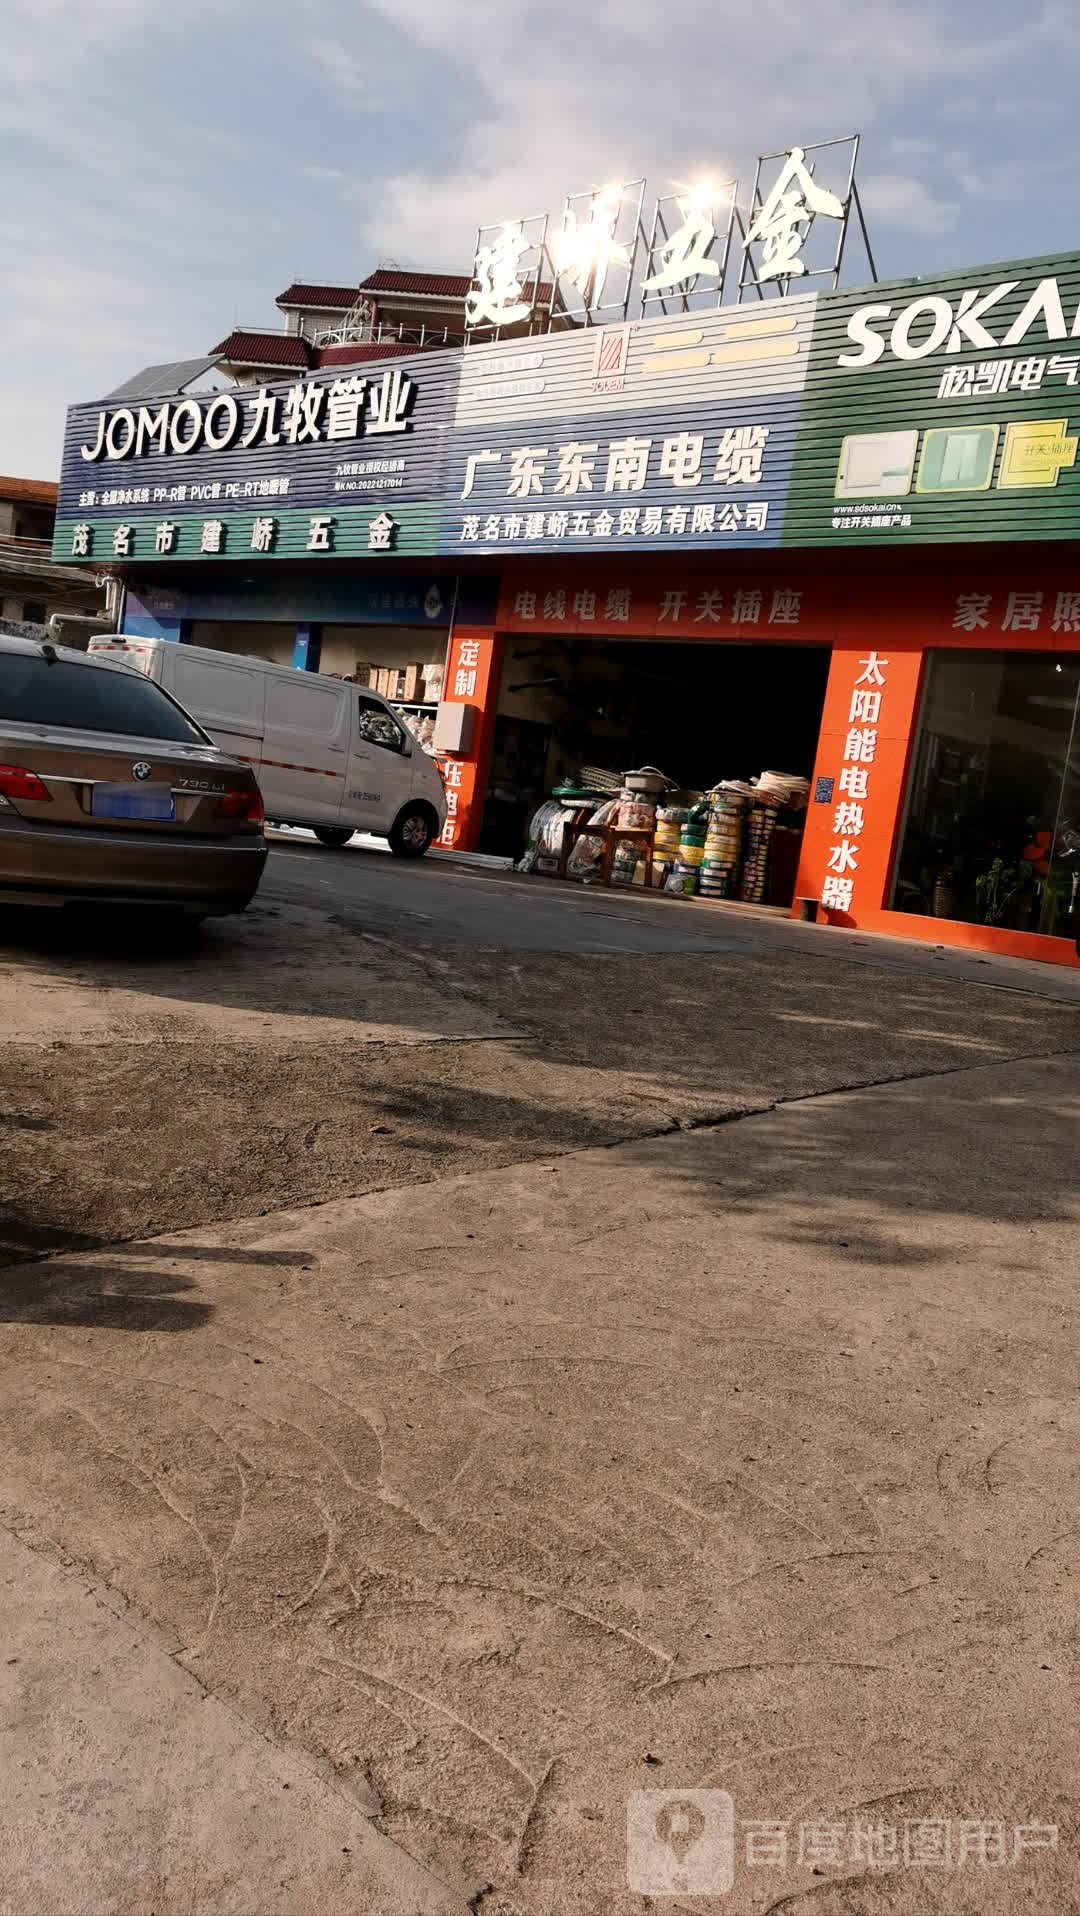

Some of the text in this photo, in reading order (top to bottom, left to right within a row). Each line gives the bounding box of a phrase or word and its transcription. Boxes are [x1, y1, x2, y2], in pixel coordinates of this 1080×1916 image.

[937, 355, 1080, 399] 松凯电气
[460, 426, 770, 501] 广东东南电缆
[153, 485, 186, 502] PP-R管
[190, 483, 221, 500] PVC管
[225, 478, 290, 498] PE-RT地暖管
[71, 512, 398, 556] 茂名市建峤五金
[460, 502, 769, 541] 茂名市建峤五金贸易有限公司
[831, 514, 912, 529] 专注开关插座产品
[514, 588, 803, 624] 电线电缆 开关插座
[454, 639, 480, 698] 定制
[821, 651, 890, 912] 太阳能电热水器
